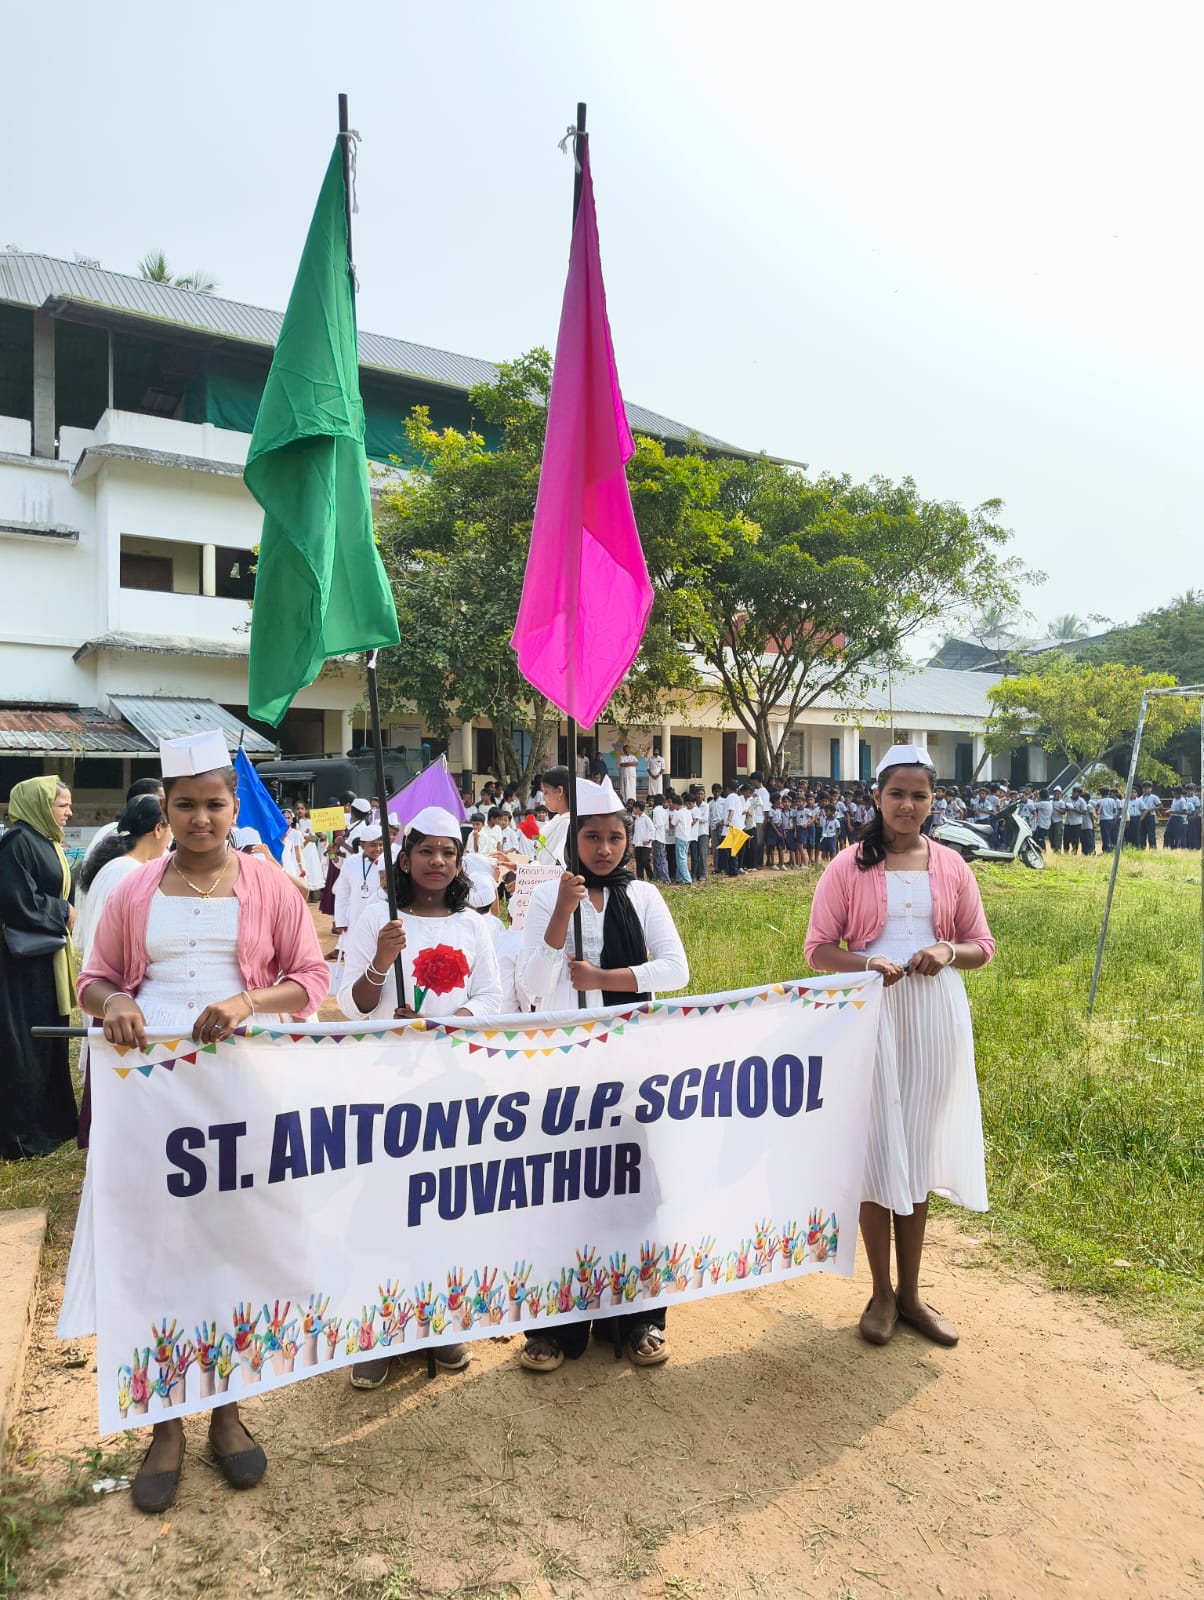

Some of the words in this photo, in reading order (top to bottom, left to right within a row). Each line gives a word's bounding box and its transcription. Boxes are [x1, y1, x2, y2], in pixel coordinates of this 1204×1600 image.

[165, 1121, 254, 1198] ST.
[267, 1091, 530, 1185] ANTONYS
[541, 1081, 625, 1136] U.P.
[634, 1053, 824, 1124] SCHOOL
[407, 1142, 642, 1228] PUVATHUR
